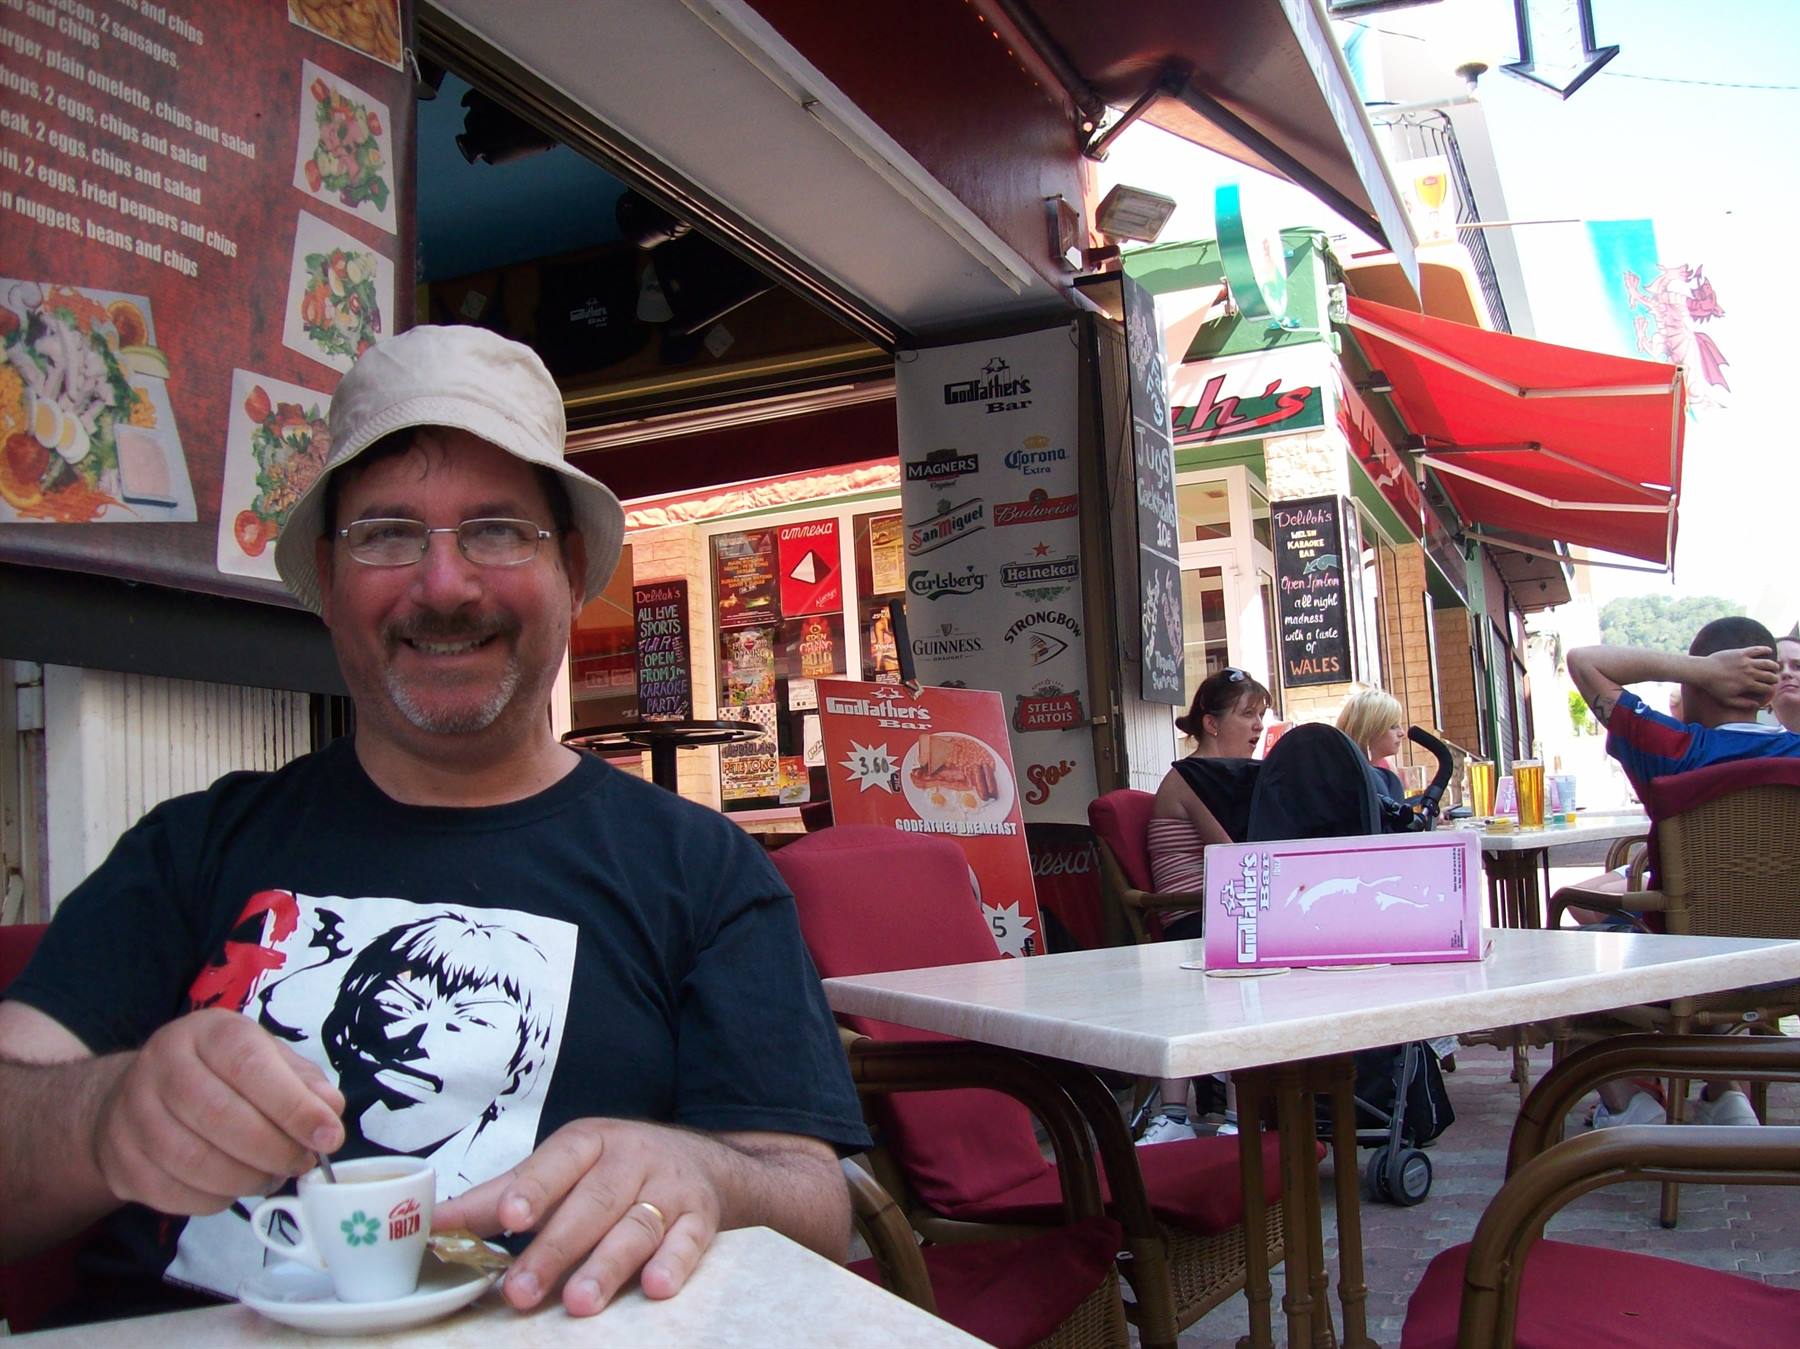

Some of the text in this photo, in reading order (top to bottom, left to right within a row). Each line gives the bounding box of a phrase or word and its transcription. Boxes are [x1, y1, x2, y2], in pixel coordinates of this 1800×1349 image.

[26, 1, 100, 50] and chips
[141, 1, 204, 46] and chips
[100, 12, 110, 33] 2
[111, 21, 180, 71] sausages,
[46, 48, 85, 81] plain
[87, 68, 154, 115] omelette,
[156, 101, 192, 131] chips
[194, 119, 219, 143] and
[221, 131, 255, 160] salad
[45, 84, 55, 106] 2
[57, 94, 98, 128] eggs,
[100, 112, 139, 143] chips
[141, 131, 167, 156] and
[170, 143, 207, 173] salad
[36, 120, 46, 143] 2
[48, 129, 88, 161] eggs,
[92, 147, 132, 178] chips
[134, 166, 161, 189] and
[164, 177, 201, 205] salad
[25, 156, 35, 178] 2
[38, 164, 79, 197] eggs,
[82, 179, 117, 210] fried
[120, 196, 178, 232] peppers
[180, 219, 205, 243] and
[206, 231, 238, 258] chips
[16, 195, 83, 237] nuggets,
[86, 218, 133, 252] beans
[135, 239, 161, 263] and
[163, 249, 198, 277] chips
[944, 374, 1032, 404] Godfather's
[986, 400, 1032, 414] Bar
[1004, 448, 1066, 472] Corona
[1136, 426, 1170, 489] Jugs
[908, 458, 977, 478] MAGNERS
[1023, 465, 1051, 476] Extra
[1274, 510, 1332, 529] Delilah's
[781, 523, 833, 540] amnesia
[1291, 530, 1317, 539] WELSH
[1287, 538, 1325, 550] KARAOKE
[1299, 548, 1315, 558] BAR
[1007, 563, 1076, 581] Heineken
[908, 568, 985, 601] Carlsberg
[1281, 574, 1305, 594] Open
[635, 587, 680, 603] Delilah's
[1294, 592, 1338, 611] all night
[638, 604, 679, 622] ALL LIVE
[1285, 612, 1324, 625] madness
[640, 619, 681, 637] SPORTS
[1004, 610, 1082, 645] STRONGBOW
[1285, 626, 1339, 642] with a taste
[913, 637, 983, 656] GUINNESS
[1306, 642, 1316, 655] of
[644, 652, 675, 667] OPEN
[1290, 656, 1340, 676] WALES
[640, 667, 668, 683] FROM
[640, 680, 688, 698] KARAOKE
[646, 696, 680, 713] PARTY
[826, 697, 931, 720] Godfather's
[1027, 702, 1072, 713] STELLA
[877, 719, 932, 730] Bar
[1027, 712, 1073, 724] ARTOIS
[895, 818, 1016, 835] GODFATHER BREAKFAST
[1260, 852, 1270, 910] Bar
[992, 916, 1008, 938] 5
[388, 1213, 421, 1241] IBIZA
